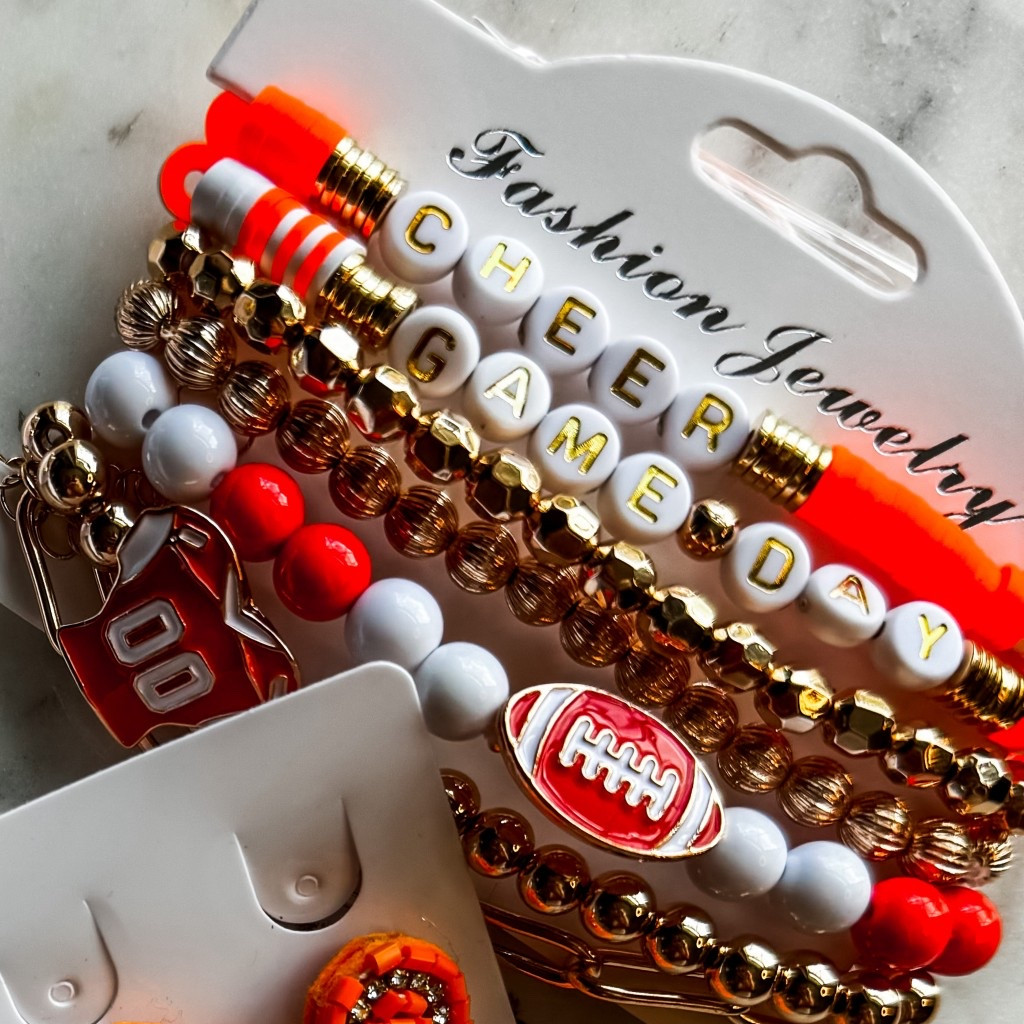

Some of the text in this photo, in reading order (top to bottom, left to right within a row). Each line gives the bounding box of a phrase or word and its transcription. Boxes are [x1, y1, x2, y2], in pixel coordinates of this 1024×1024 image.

[403, 203, 735, 455] CHEER
[445, 127, 1024, 531] Fashion Jewelry
[405, 326, 949, 662] GAME DAY
[105, 598, 216, 714] 00
